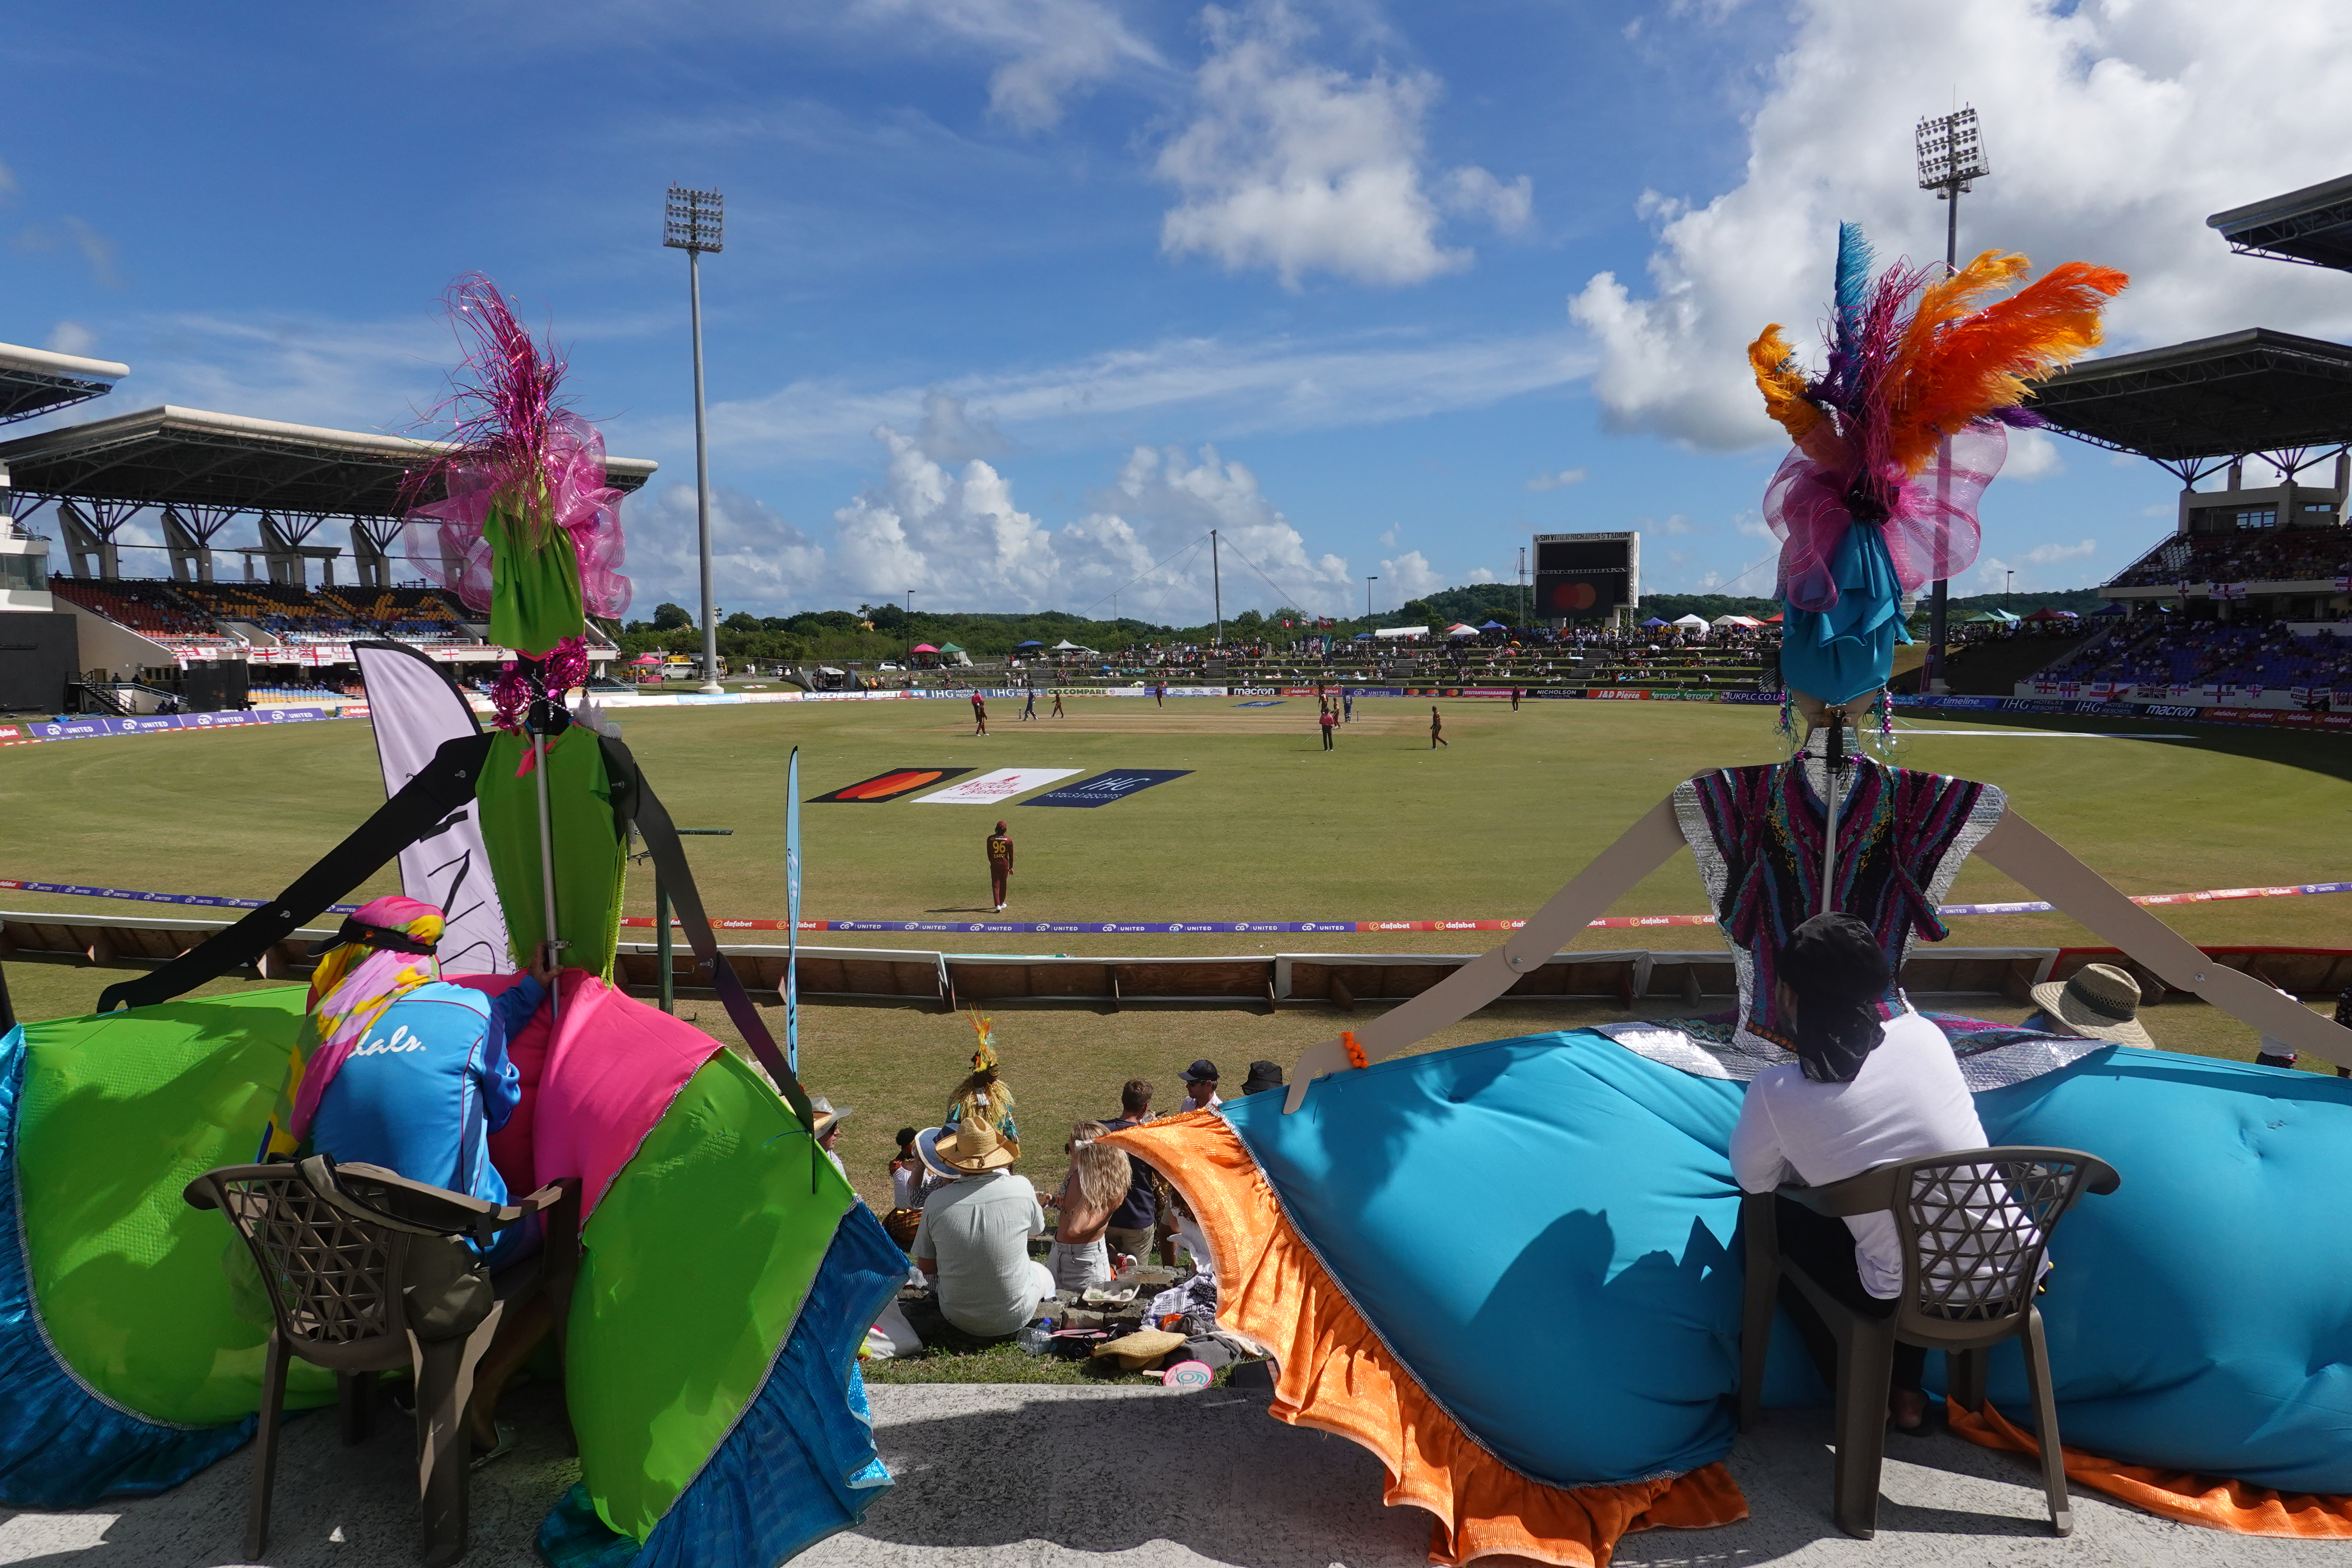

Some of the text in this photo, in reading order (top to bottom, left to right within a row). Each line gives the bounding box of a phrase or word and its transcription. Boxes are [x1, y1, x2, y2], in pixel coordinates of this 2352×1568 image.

[931, 689, 953, 698] IHG
[2002, 699, 2031, 709] IHG
[2075, 701, 2103, 712] IHG
[2146, 705, 2196, 717] macron
[2213, 709, 2237, 717] dafabet
[272, 712, 285, 720] CG
[2288, 714, 2312, 722] dafabet
[2324, 716, 2350, 724] dafabet
[122, 721, 135, 730] CG
[197, 717, 211, 725] CG
[47, 727, 61, 735] CG
[1079, 778, 1153, 790] IHG
[992, 841, 1006, 854] 96
